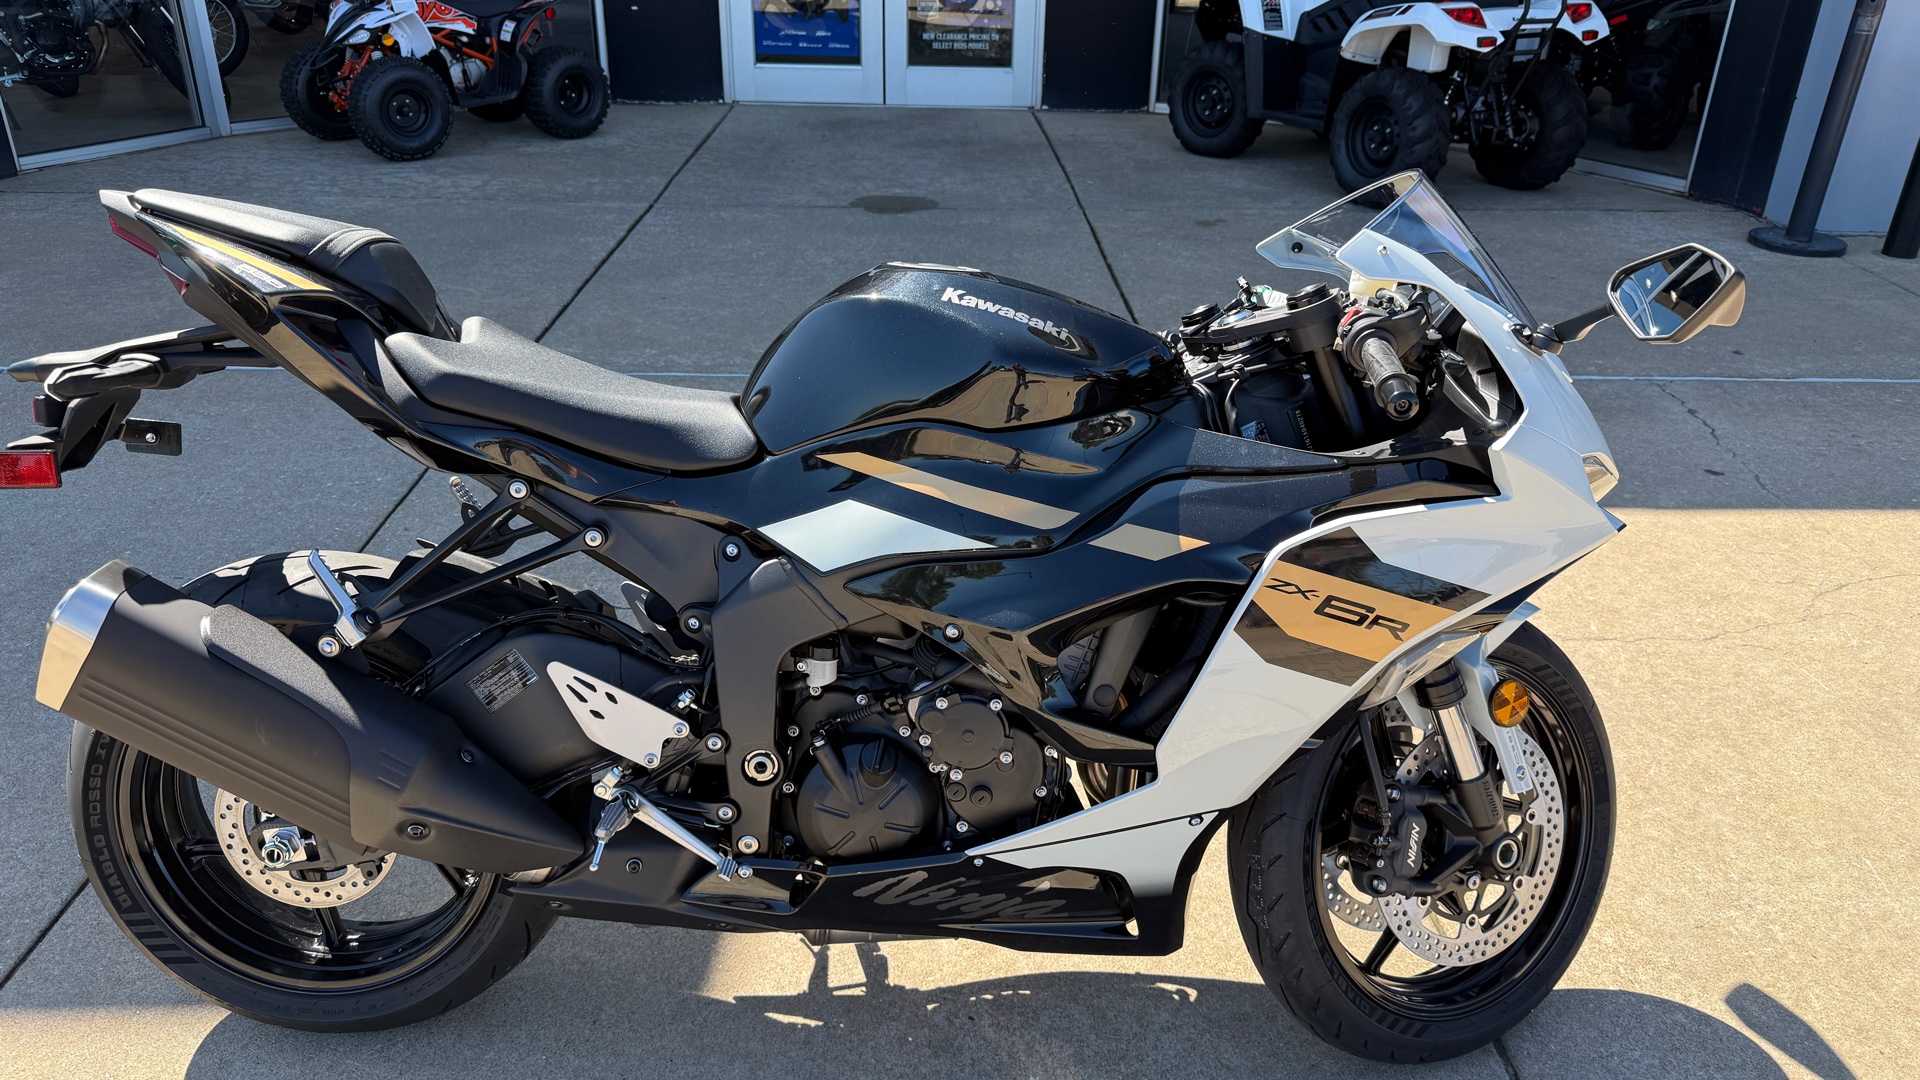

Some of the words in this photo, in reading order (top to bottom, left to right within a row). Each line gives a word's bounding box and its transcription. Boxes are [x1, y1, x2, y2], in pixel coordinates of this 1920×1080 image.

[922, 32, 935, 40] NEW
[936, 33, 968, 41] CLEARANCE
[969, 33, 990, 41] PRICING
[932, 41, 952, 49] SELECT
[968, 42, 989, 50] MODELS
[940, 286, 1069, 341] Kawasaki
[1263, 577, 1411, 642] ZX-6R
[1584, 731, 1605, 776] PIRELLI
[88, 763, 104, 829] ROSSO
[1406, 822, 1421, 868] NISSIN
[93, 833, 133, 910] DIABLO
[852, 870, 1069, 921] Ninja
